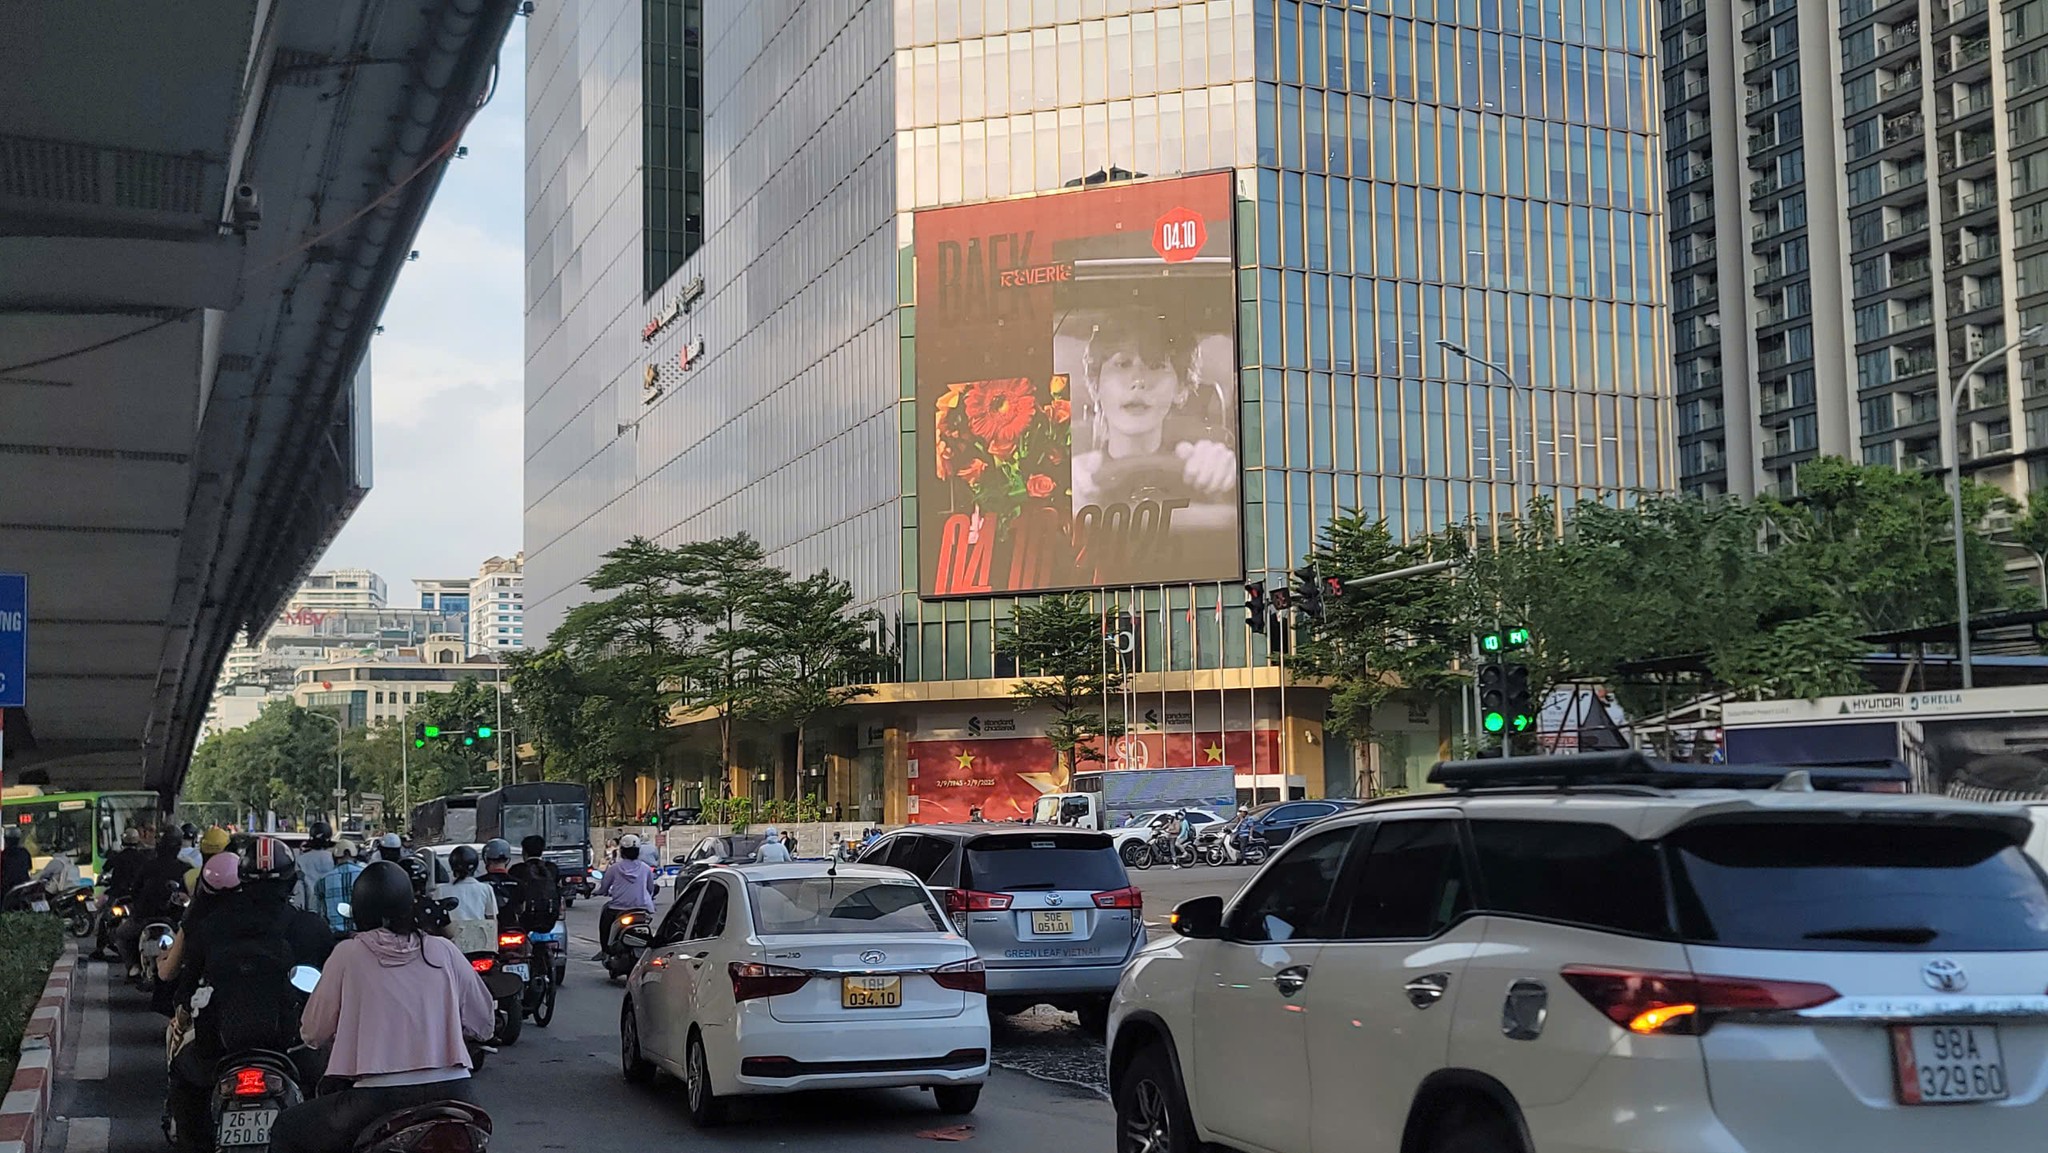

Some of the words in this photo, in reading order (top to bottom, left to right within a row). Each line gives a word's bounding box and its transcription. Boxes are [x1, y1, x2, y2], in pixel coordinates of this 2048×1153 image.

[1162, 221, 1196, 251] 04.10
[1853, 697, 1904, 710] HYUNDAI
[1922, 693, 1962, 705] GHELLA
[1044, 912, 1062, 921] 50E
[1038, 922, 1069, 932] 051.01
[1004, 949, 1037, 958] GREEN
[1038, 948, 1061, 958] LEAF
[1062, 946, 1101, 957] VIETNAM
[849, 992, 895, 1006] 034.10
[1933, 1028, 1980, 1060] 98A
[229, 1111, 270, 1128] 26-K1
